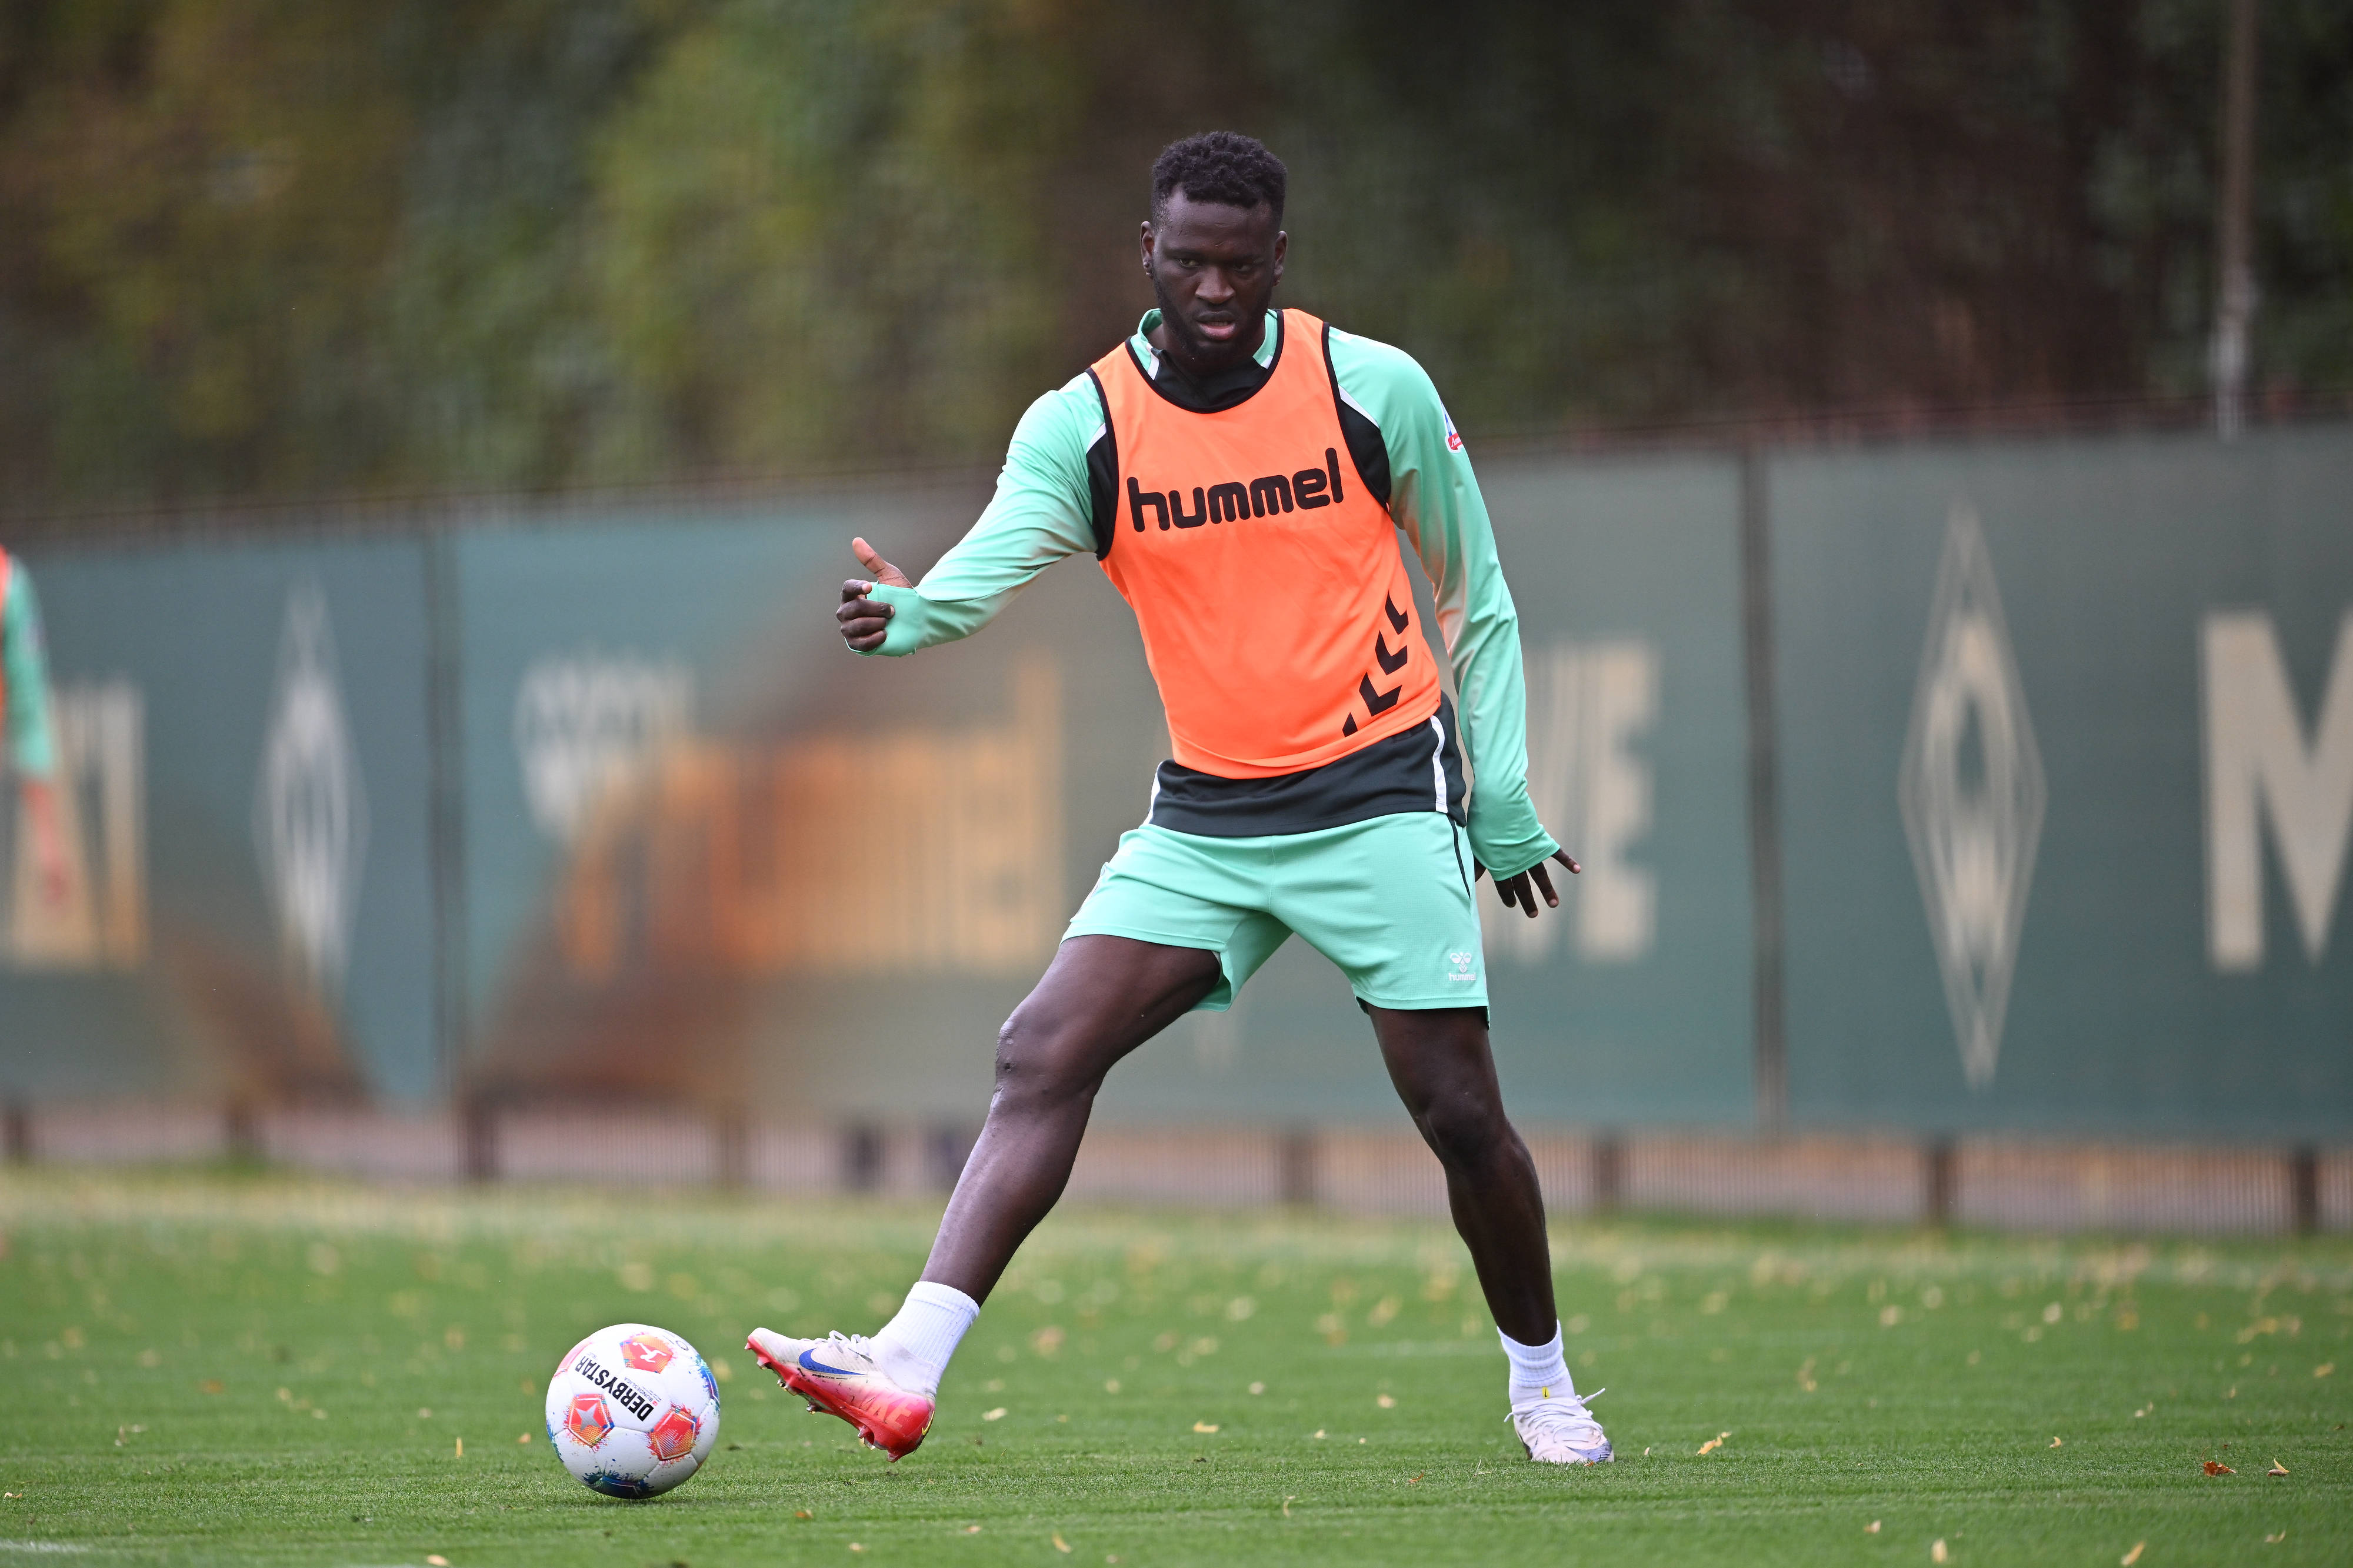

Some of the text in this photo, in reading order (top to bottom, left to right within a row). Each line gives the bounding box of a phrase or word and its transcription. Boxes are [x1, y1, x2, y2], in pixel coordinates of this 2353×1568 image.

[1126, 448, 1344, 532] hummel
[1449, 972, 1476, 981] hummel
[575, 1356, 654, 1422] DERBYSTAR
[624, 1377, 653, 1402] BUNDESLIGA
